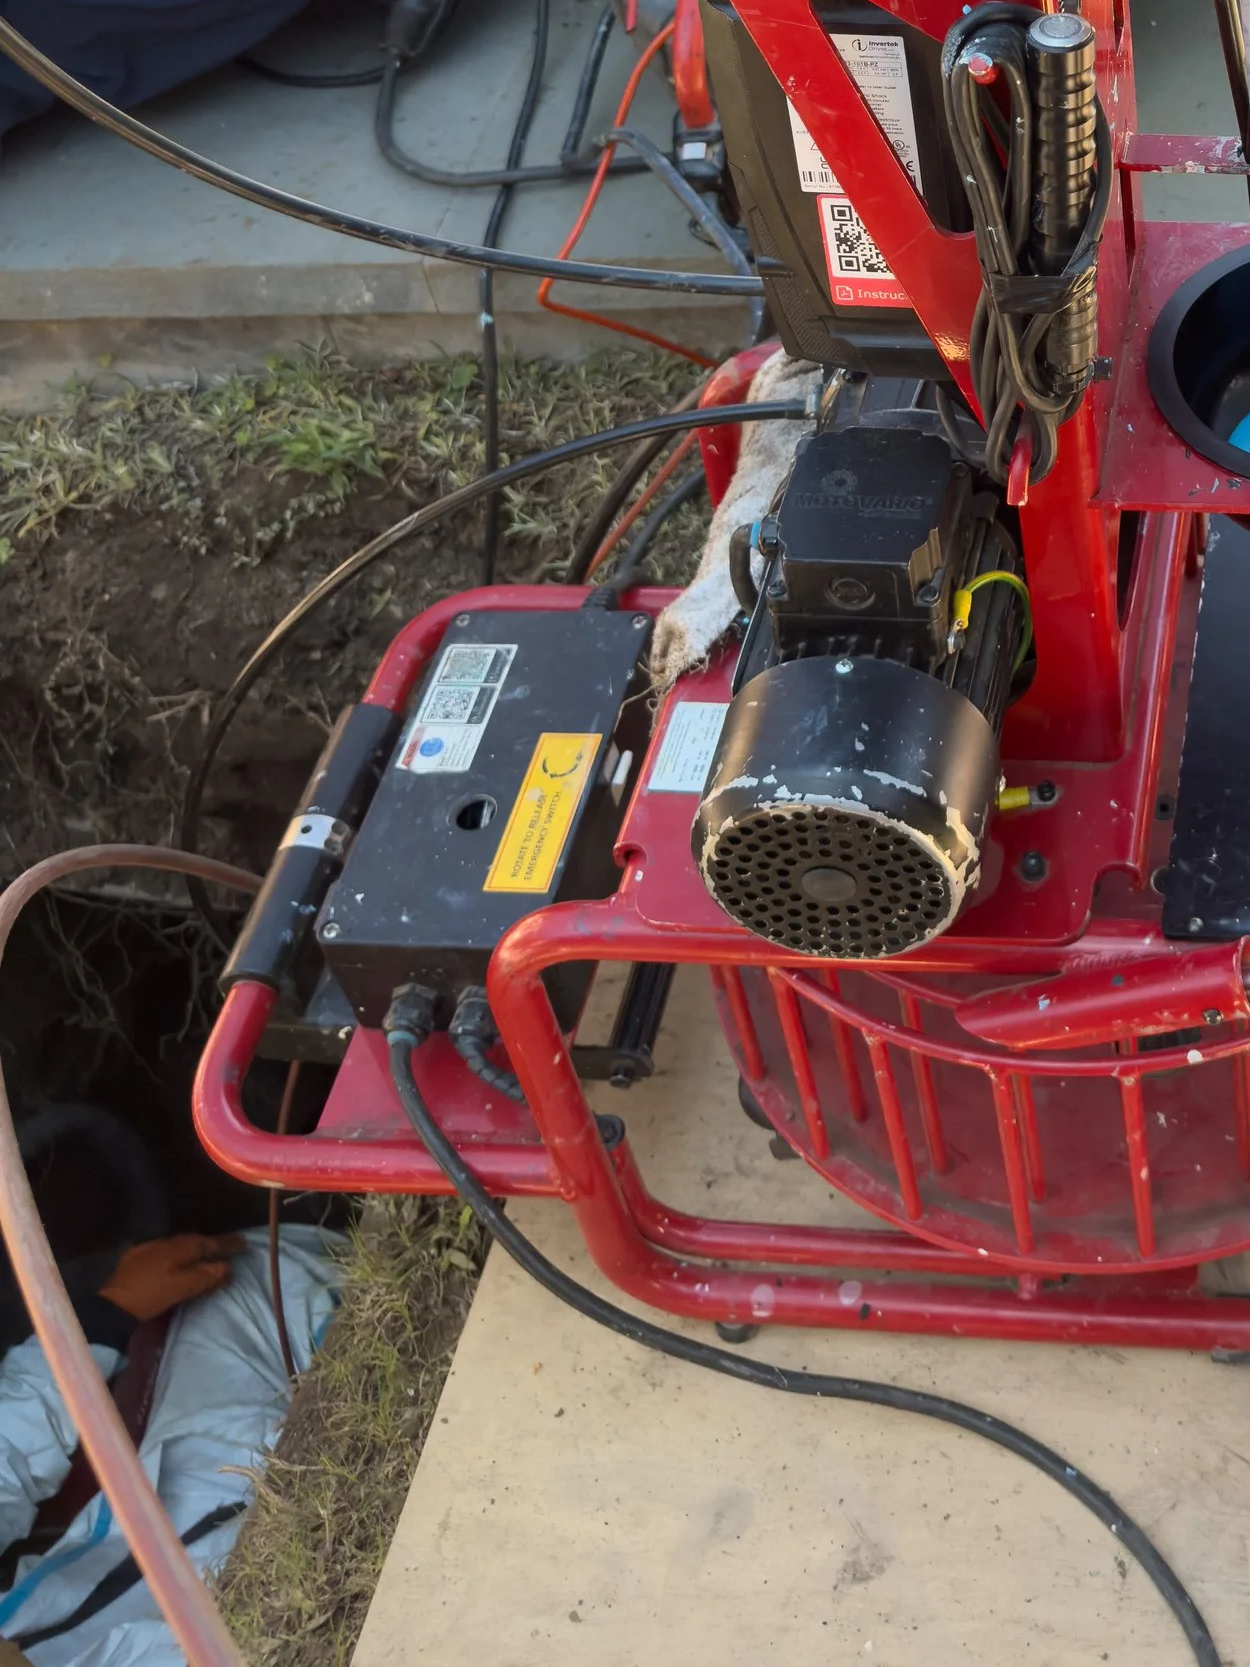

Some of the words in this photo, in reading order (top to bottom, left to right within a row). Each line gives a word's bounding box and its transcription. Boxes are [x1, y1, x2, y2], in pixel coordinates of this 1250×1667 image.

[857, 289, 907, 301] Instruc
[510, 845, 529, 878] ROTATE
[522, 831, 535, 844] TO
[523, 826, 550, 881] EMERGENCY
[543, 791, 562, 824] SWITCH
